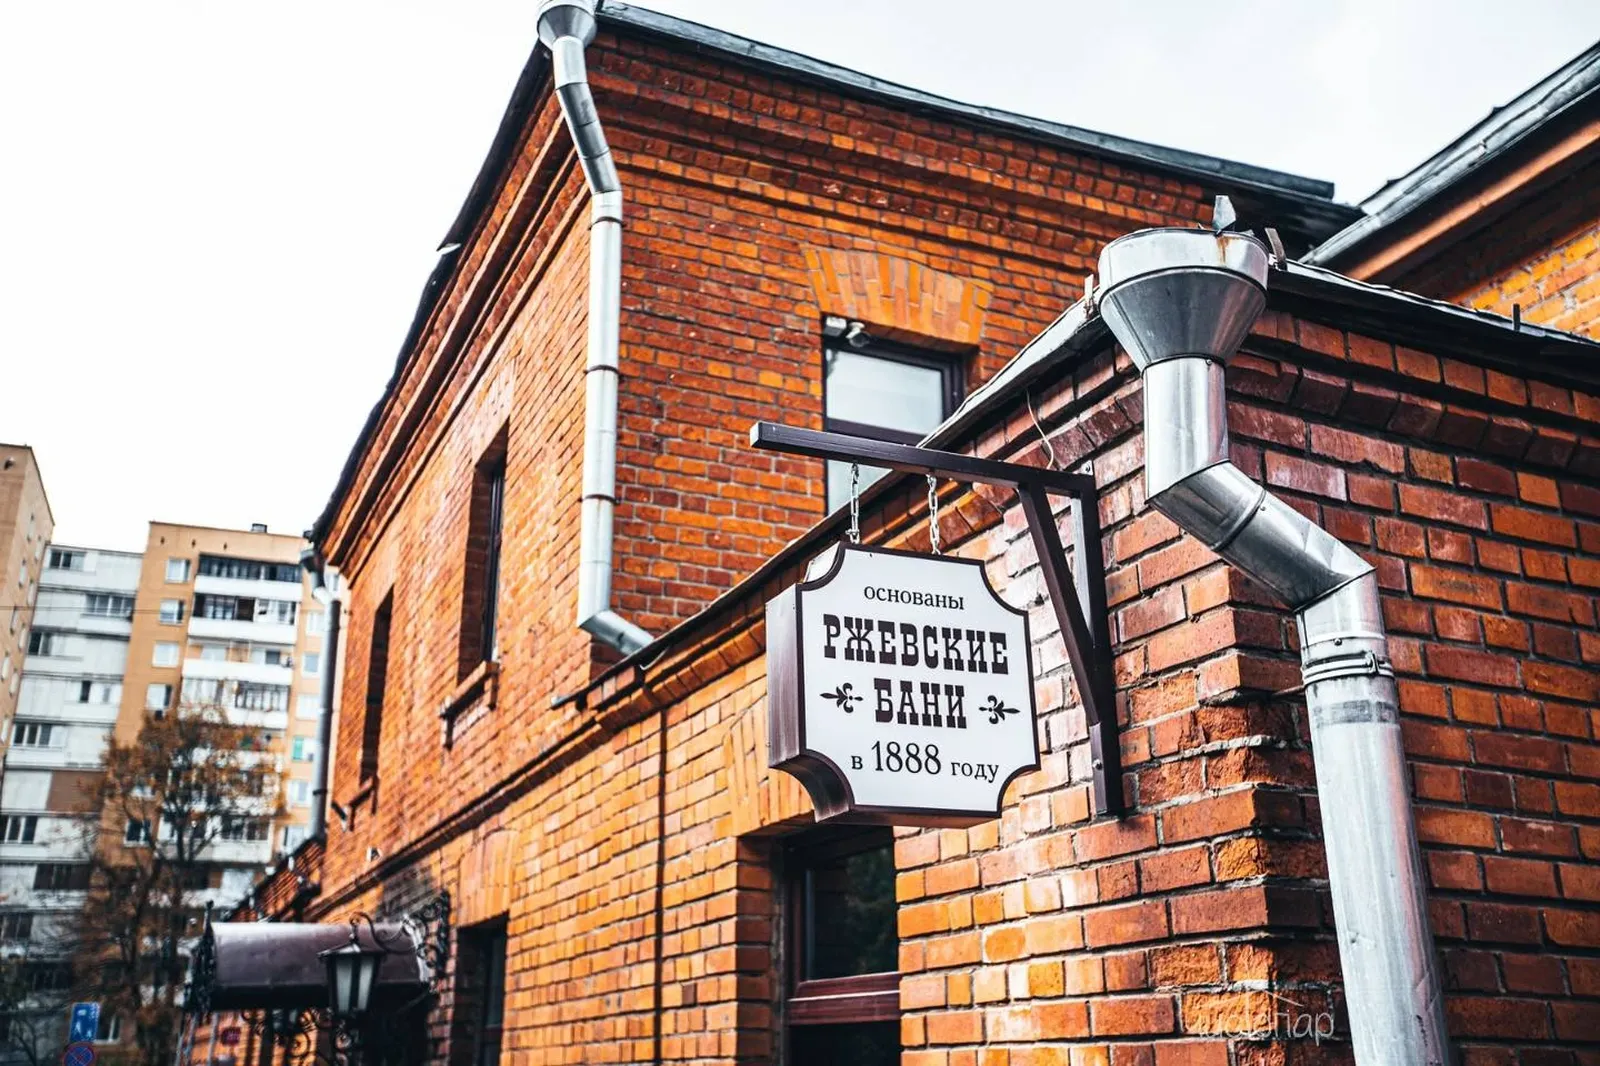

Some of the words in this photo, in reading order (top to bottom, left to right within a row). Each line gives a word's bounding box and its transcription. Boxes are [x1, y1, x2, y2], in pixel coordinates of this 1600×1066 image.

[863, 585, 966, 611] основаны
[823, 613, 1009, 676] РЖЕВСКИЕ
[873, 677, 968, 730] БАНИ
[850, 755, 864, 770] в
[871, 740, 943, 775] 1888
[950, 762, 1000, 784] году
